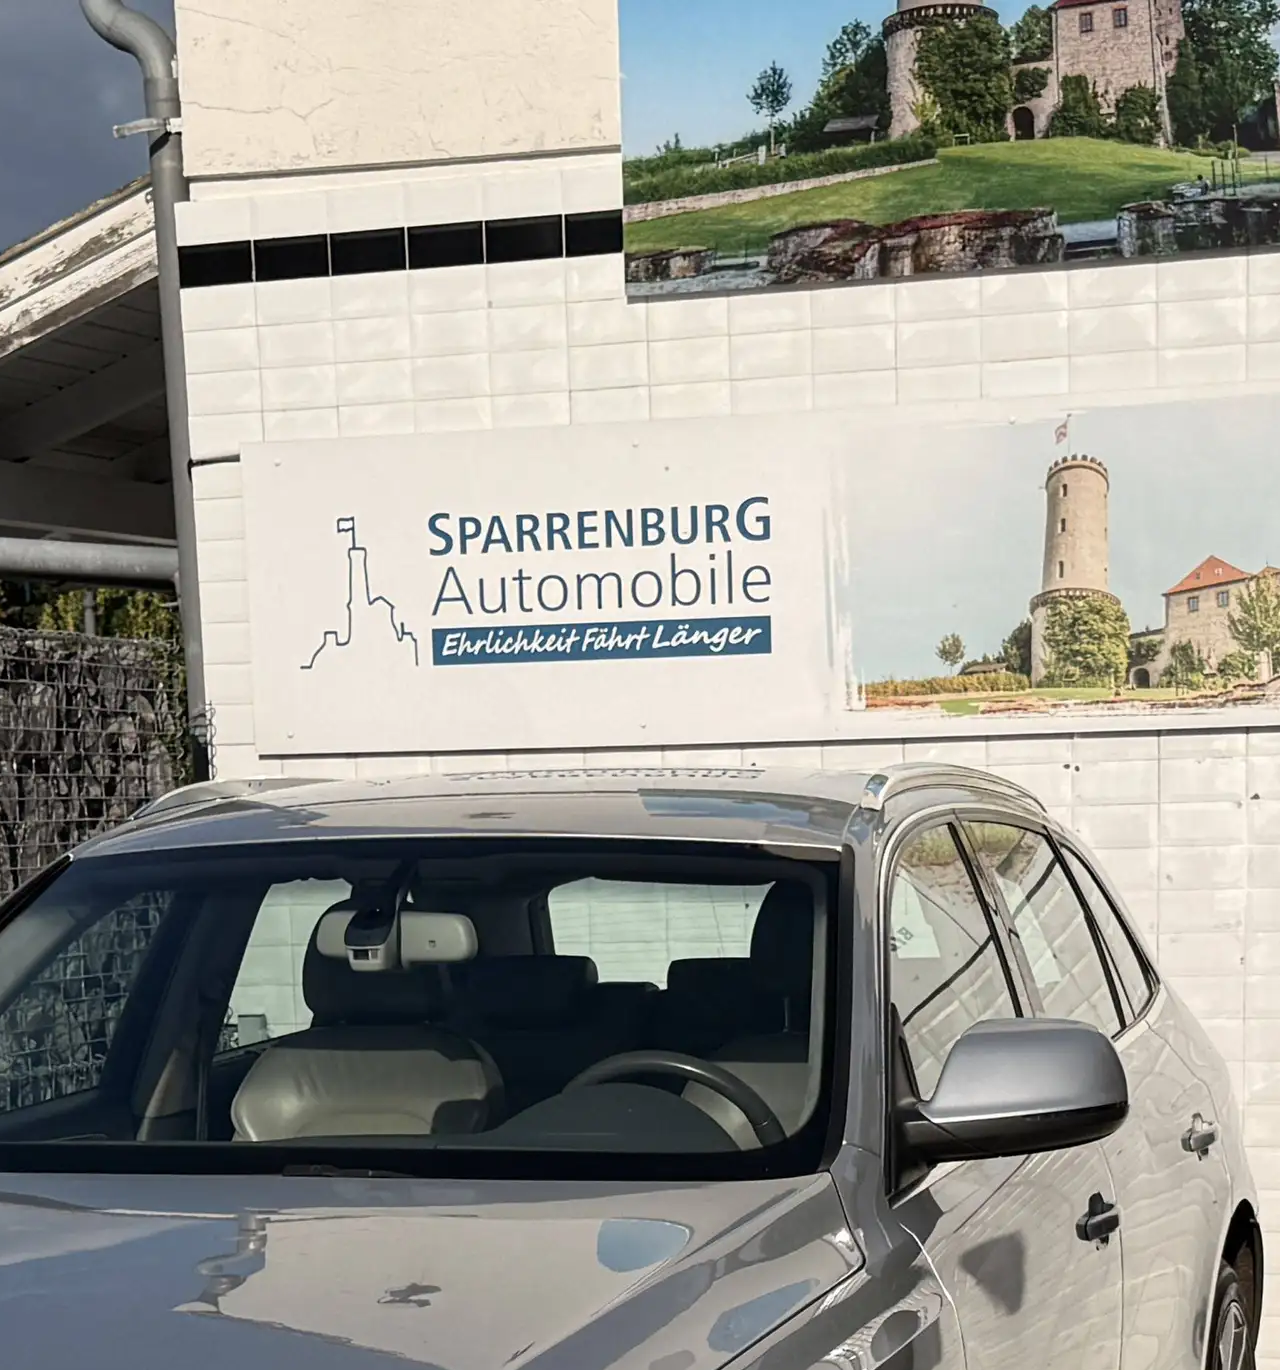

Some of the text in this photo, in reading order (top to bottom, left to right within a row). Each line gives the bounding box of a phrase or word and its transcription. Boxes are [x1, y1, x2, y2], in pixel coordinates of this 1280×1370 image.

[428, 496, 771, 556] SPARRENBURG
[431, 550, 772, 616] Automobile
[442, 622, 762, 657] Ehrlichkeit Fährt Länger
